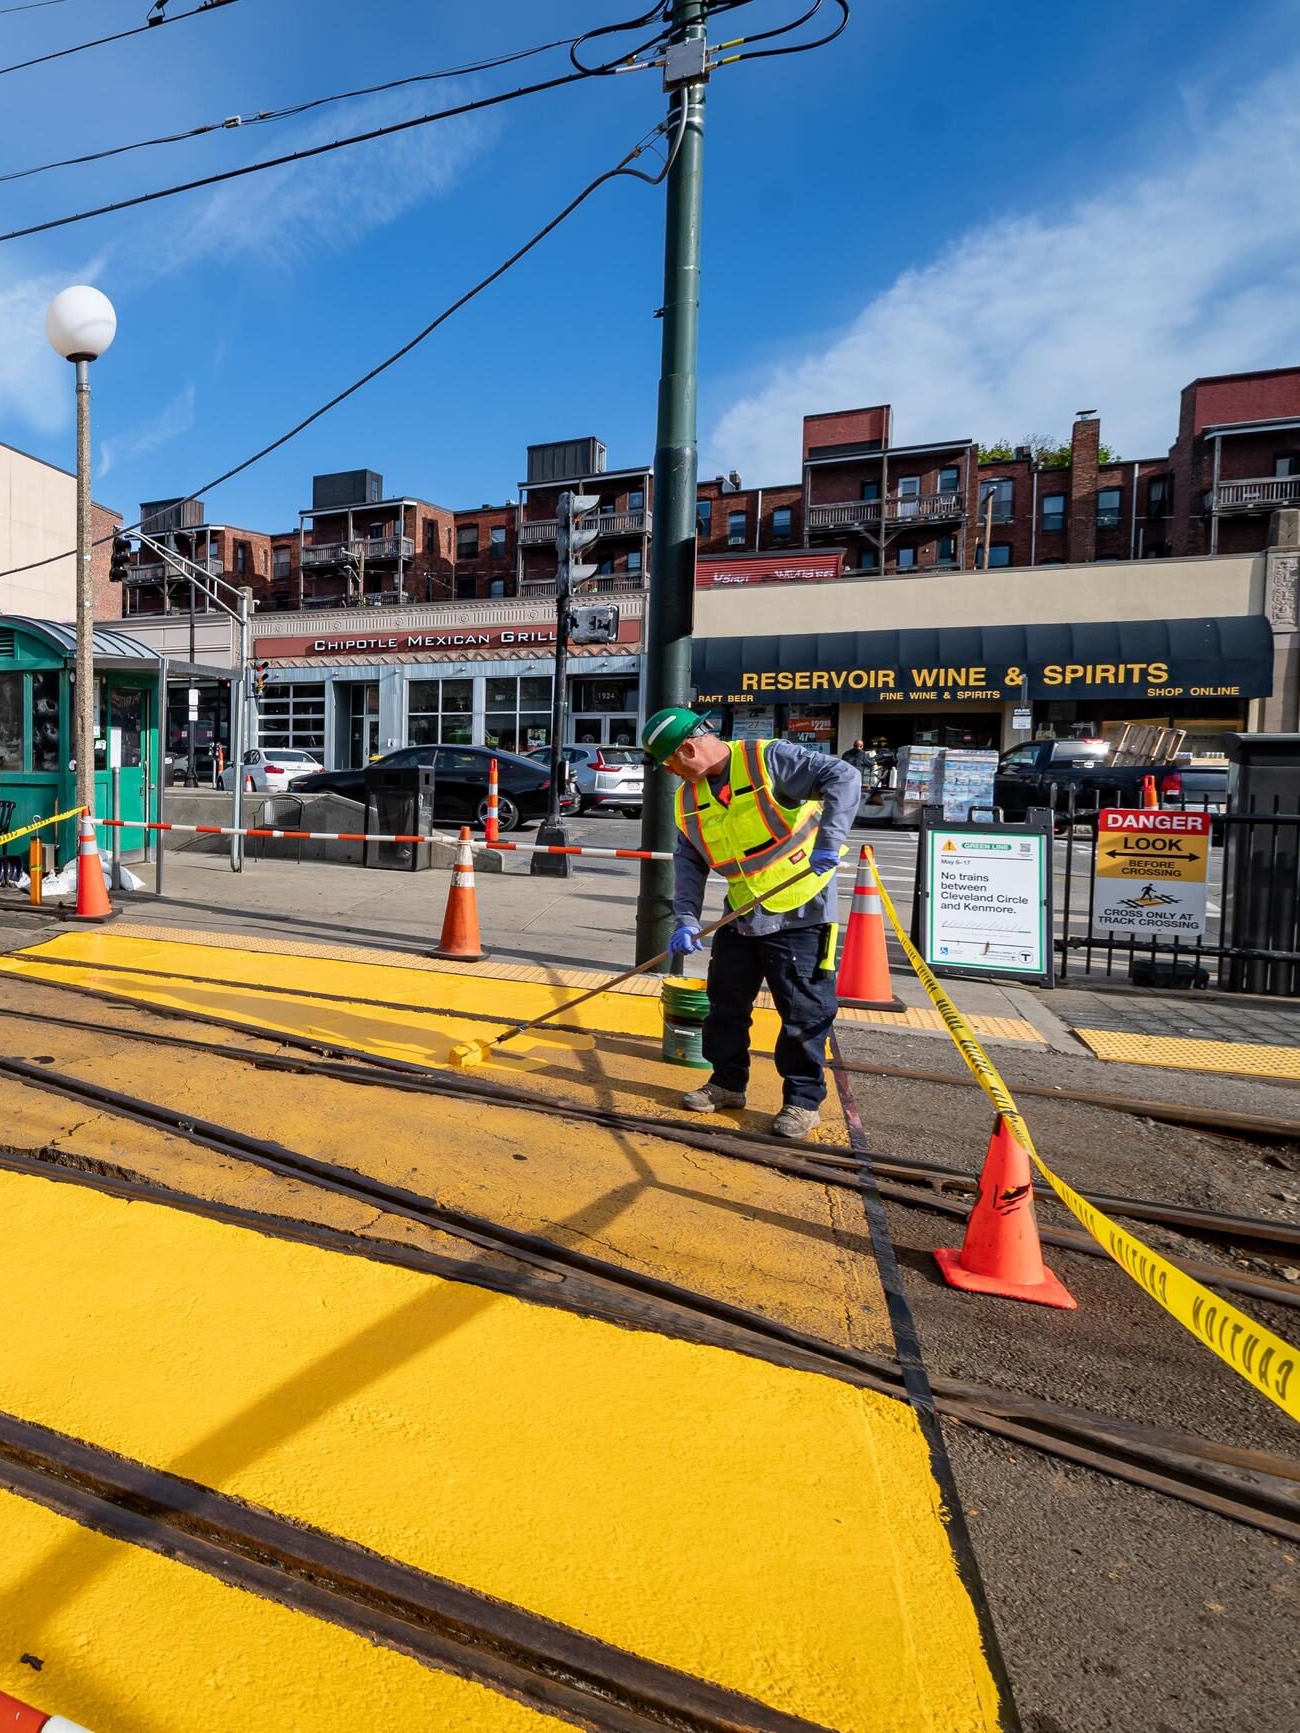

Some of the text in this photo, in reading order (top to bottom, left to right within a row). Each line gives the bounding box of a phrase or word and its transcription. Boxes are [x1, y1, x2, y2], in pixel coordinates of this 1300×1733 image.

[314, 631, 557, 651] CHIPOTLE MEXICAN GRILL
[742, 663, 1169, 691] RESERVOIR WINE & SPIRITS
[880, 690, 1000, 700] FINE WINE & SPIRITS
[1147, 686, 1240, 697] SHOP ONLINE
[698, 694, 754, 703] RAFT BEER
[1107, 814, 1203, 831] DANGER
[964, 842, 991, 850] GREEN
[1124, 837, 1183, 852] LOOK
[1129, 860, 1175, 869] BEFORE
[941, 872, 989, 882] No trains
[1121, 867, 1182, 878] CROSSING
[941, 882, 987, 892] between
[941, 891, 1029, 905] Cleveland Circle
[941, 902, 1017, 914] and Kenmore.
[1104, 908, 1194, 921] CROSS ONLY AT
[1098, 915, 1200, 930] TRACK CROSSING
